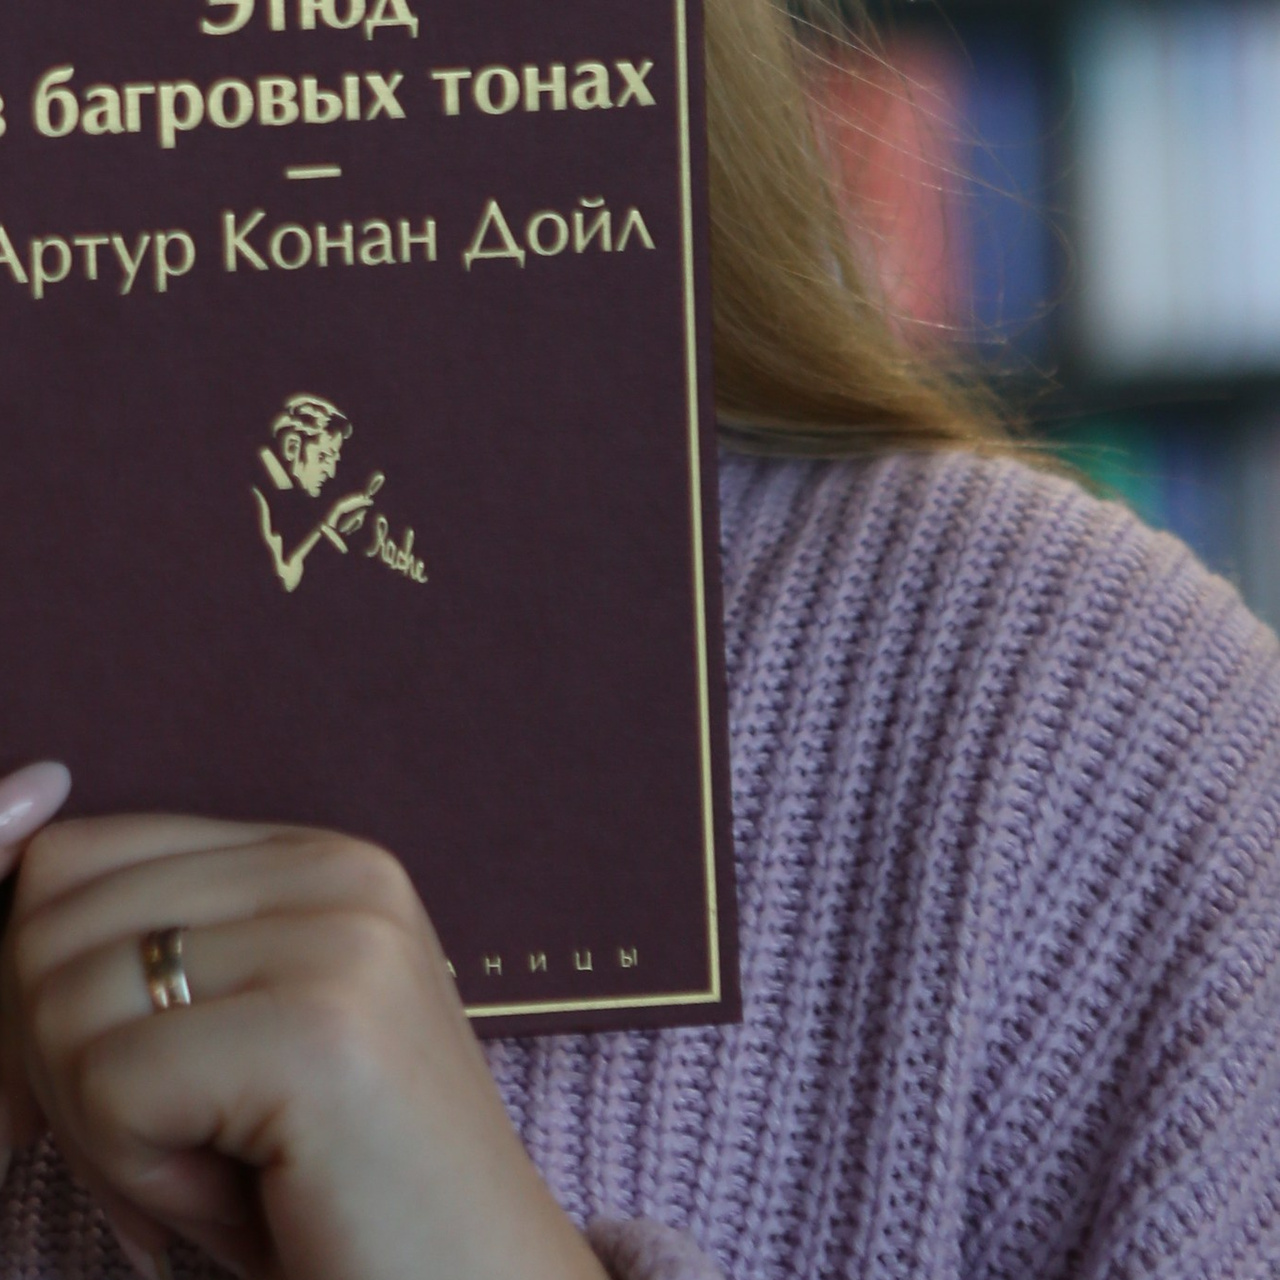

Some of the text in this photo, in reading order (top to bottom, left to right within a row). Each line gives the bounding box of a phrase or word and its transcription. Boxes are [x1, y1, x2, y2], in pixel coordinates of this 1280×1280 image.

[33, 66, 407, 149] багровых
[431, 60, 656, 116] тонах
[223, 211, 438, 273] Конан
[462, 198, 657, 270] Дойл
